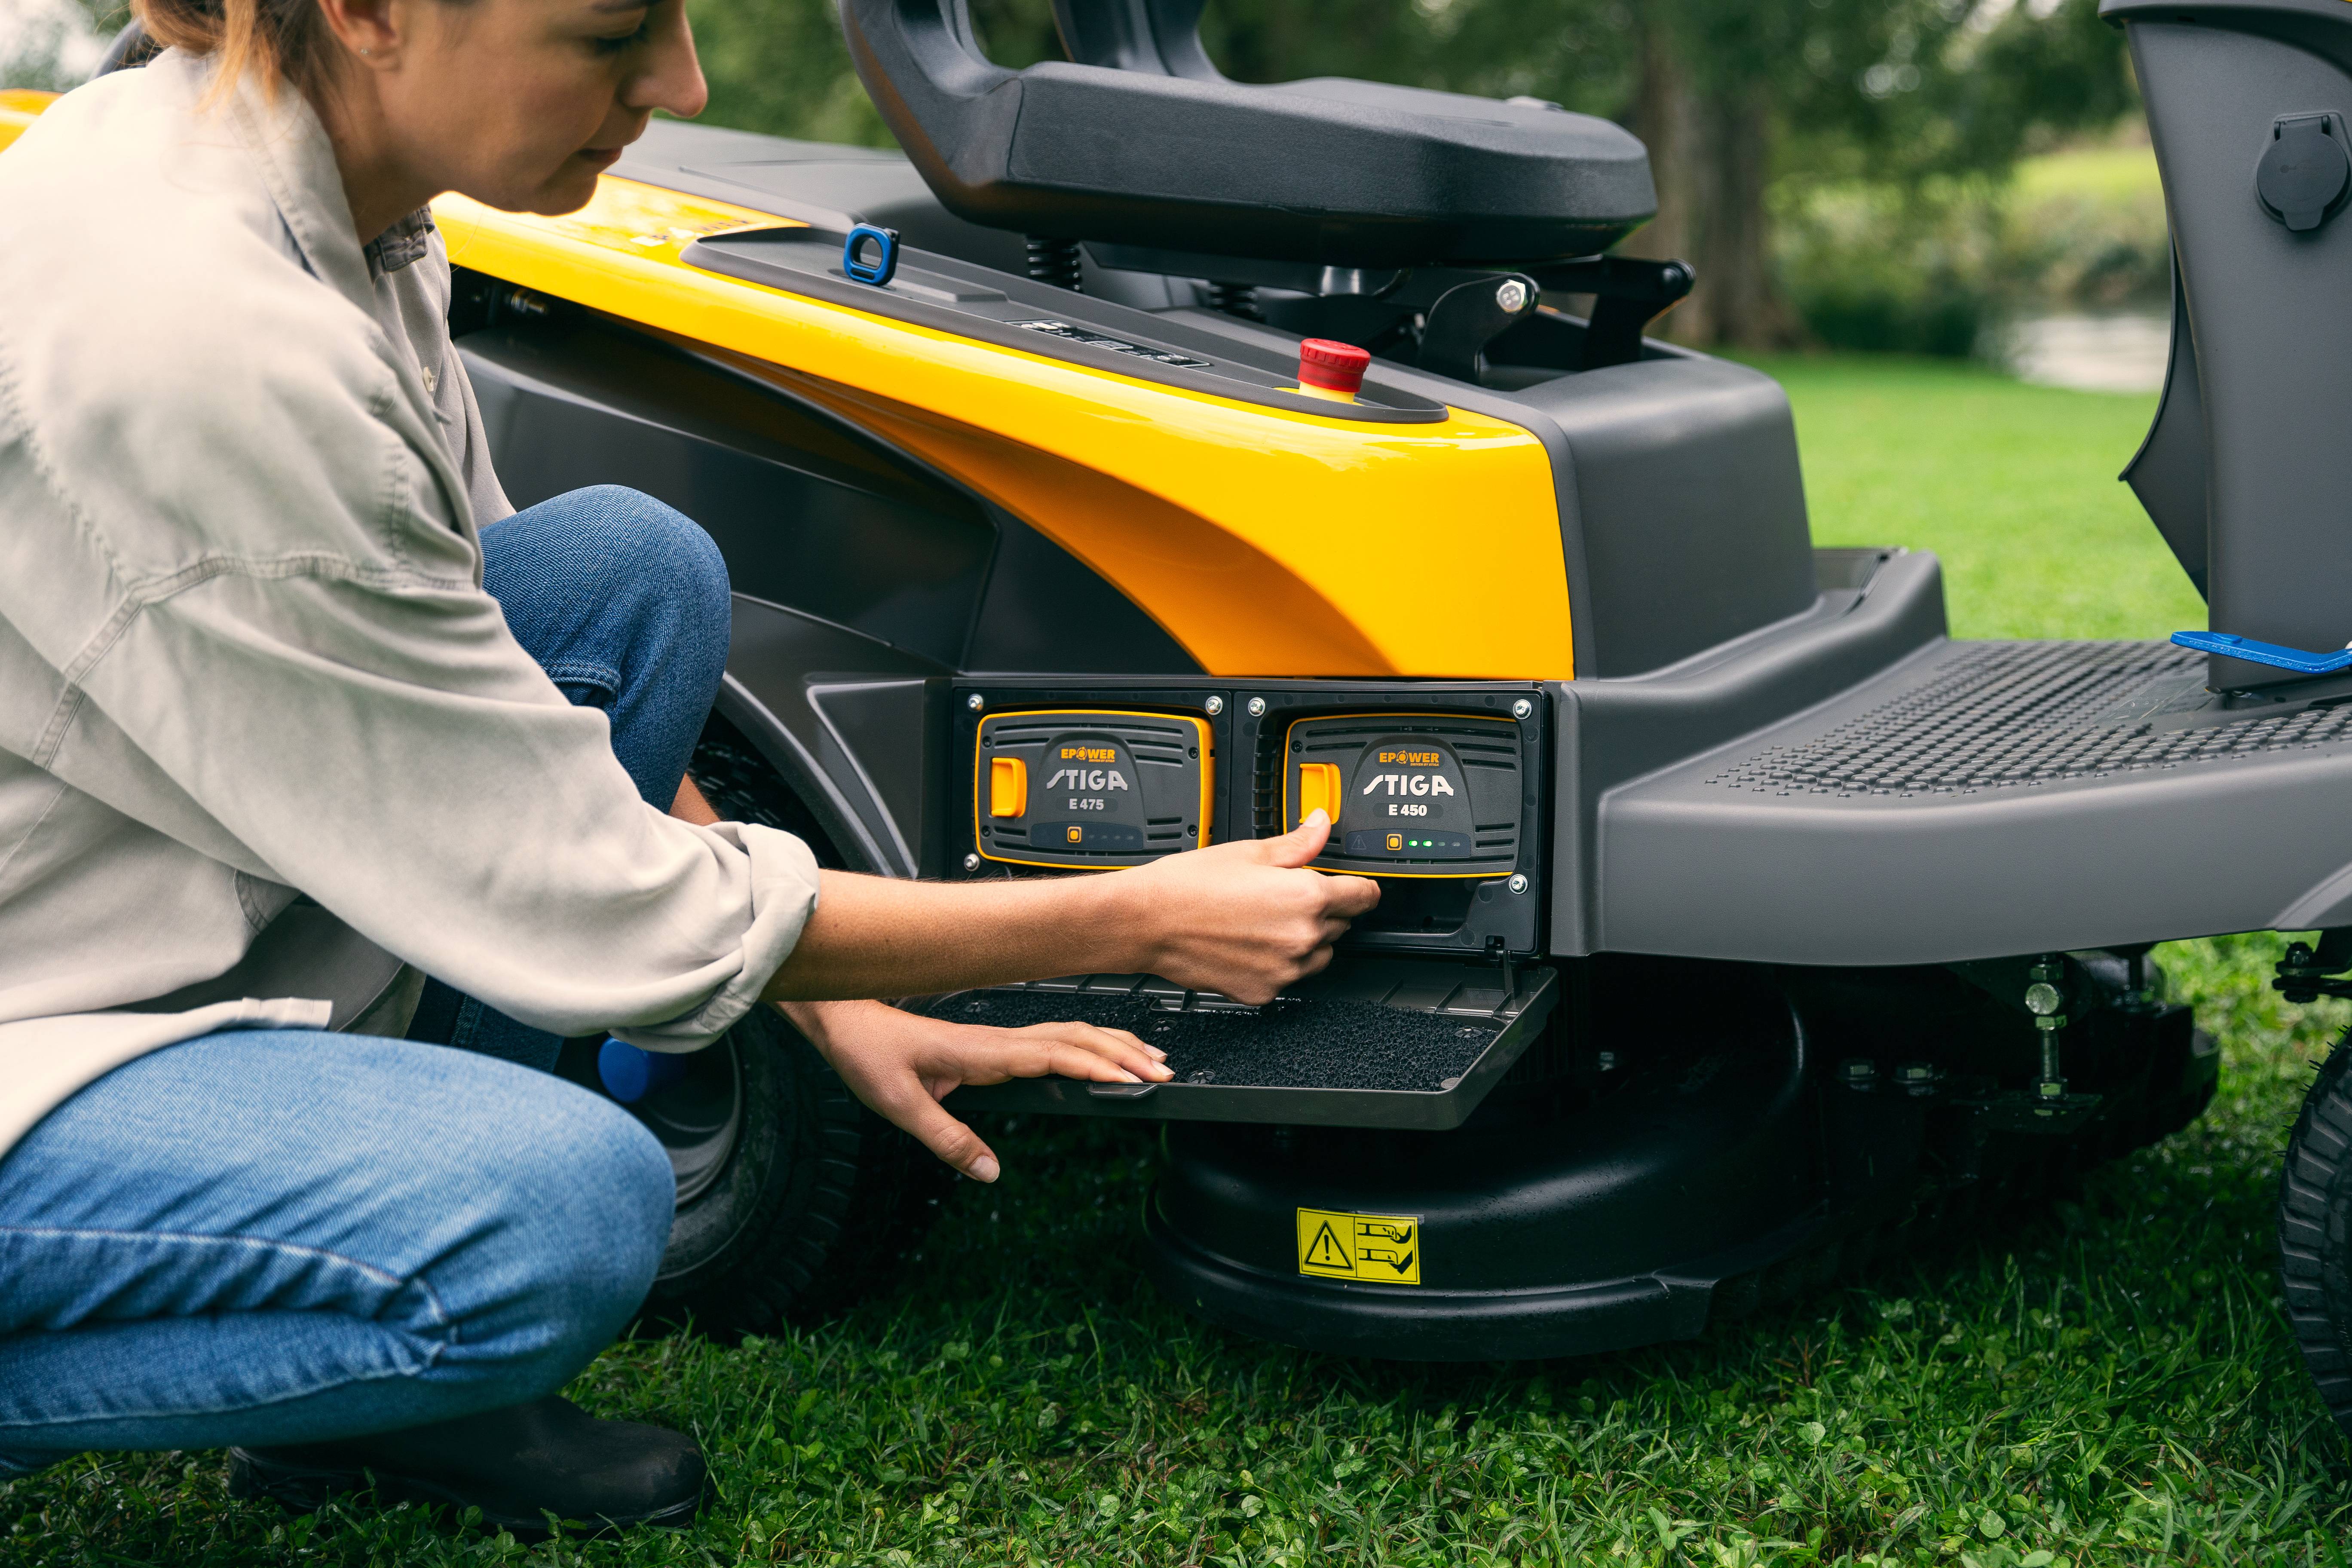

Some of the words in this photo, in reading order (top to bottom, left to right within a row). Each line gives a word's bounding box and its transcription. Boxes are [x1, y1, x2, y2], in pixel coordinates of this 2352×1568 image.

[1060, 747, 1115, 760] EPOWER
[1379, 750, 1439, 764] EPOWER
[1046, 769, 1128, 791] STIGA
[1363, 775, 1454, 796] STIGA
[1069, 798, 1077, 809] E
[1080, 799, 1104, 810] 475
[1388, 804, 1398, 816] E
[1400, 804, 1427, 816] 450
